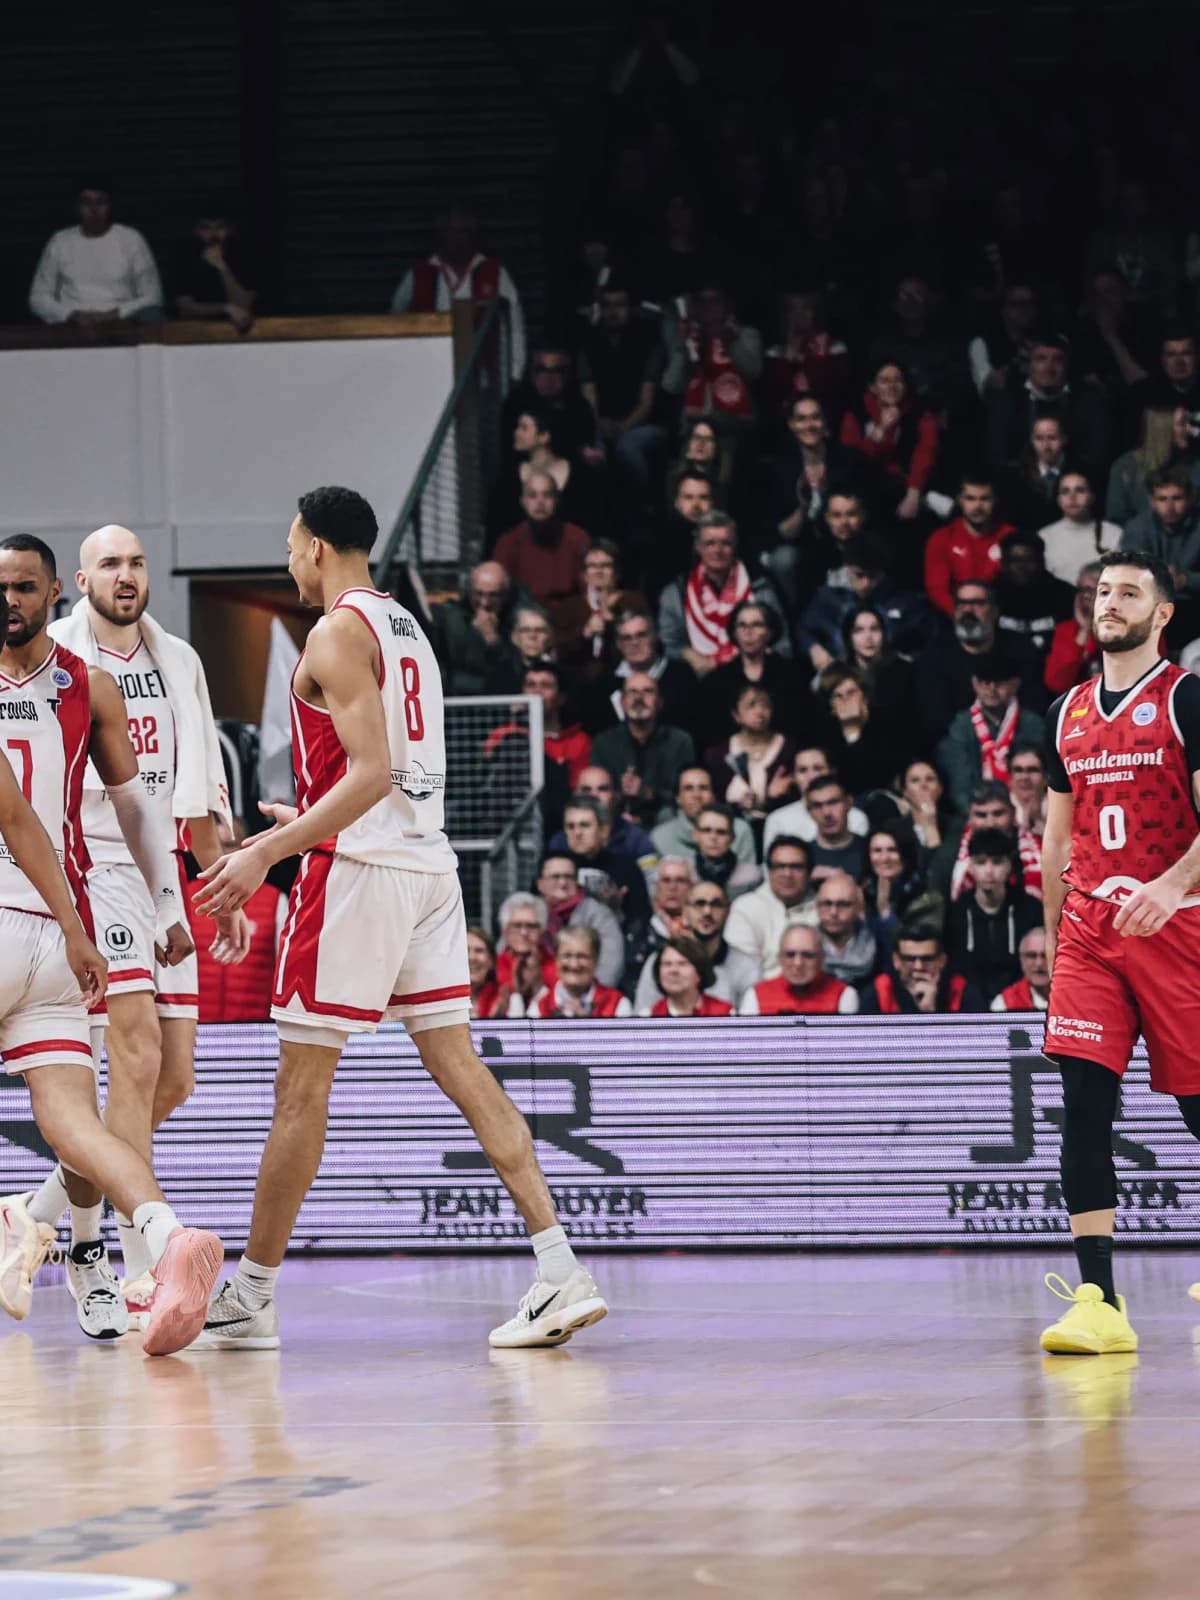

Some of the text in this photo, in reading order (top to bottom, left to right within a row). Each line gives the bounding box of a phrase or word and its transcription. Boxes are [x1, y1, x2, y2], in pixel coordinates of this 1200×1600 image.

[400, 657, 424, 741] 8
[127, 715, 159, 756] 32
[1064, 747, 1166, 776] Casademont
[1085, 770, 1135, 785] ZARAGOZA
[1100, 804, 1127, 850] 0
[1057, 1015, 1104, 1031] Zaragoza
[420, 1188, 499, 1224] JEAN
[1044, 1182, 1180, 1209] RYER
